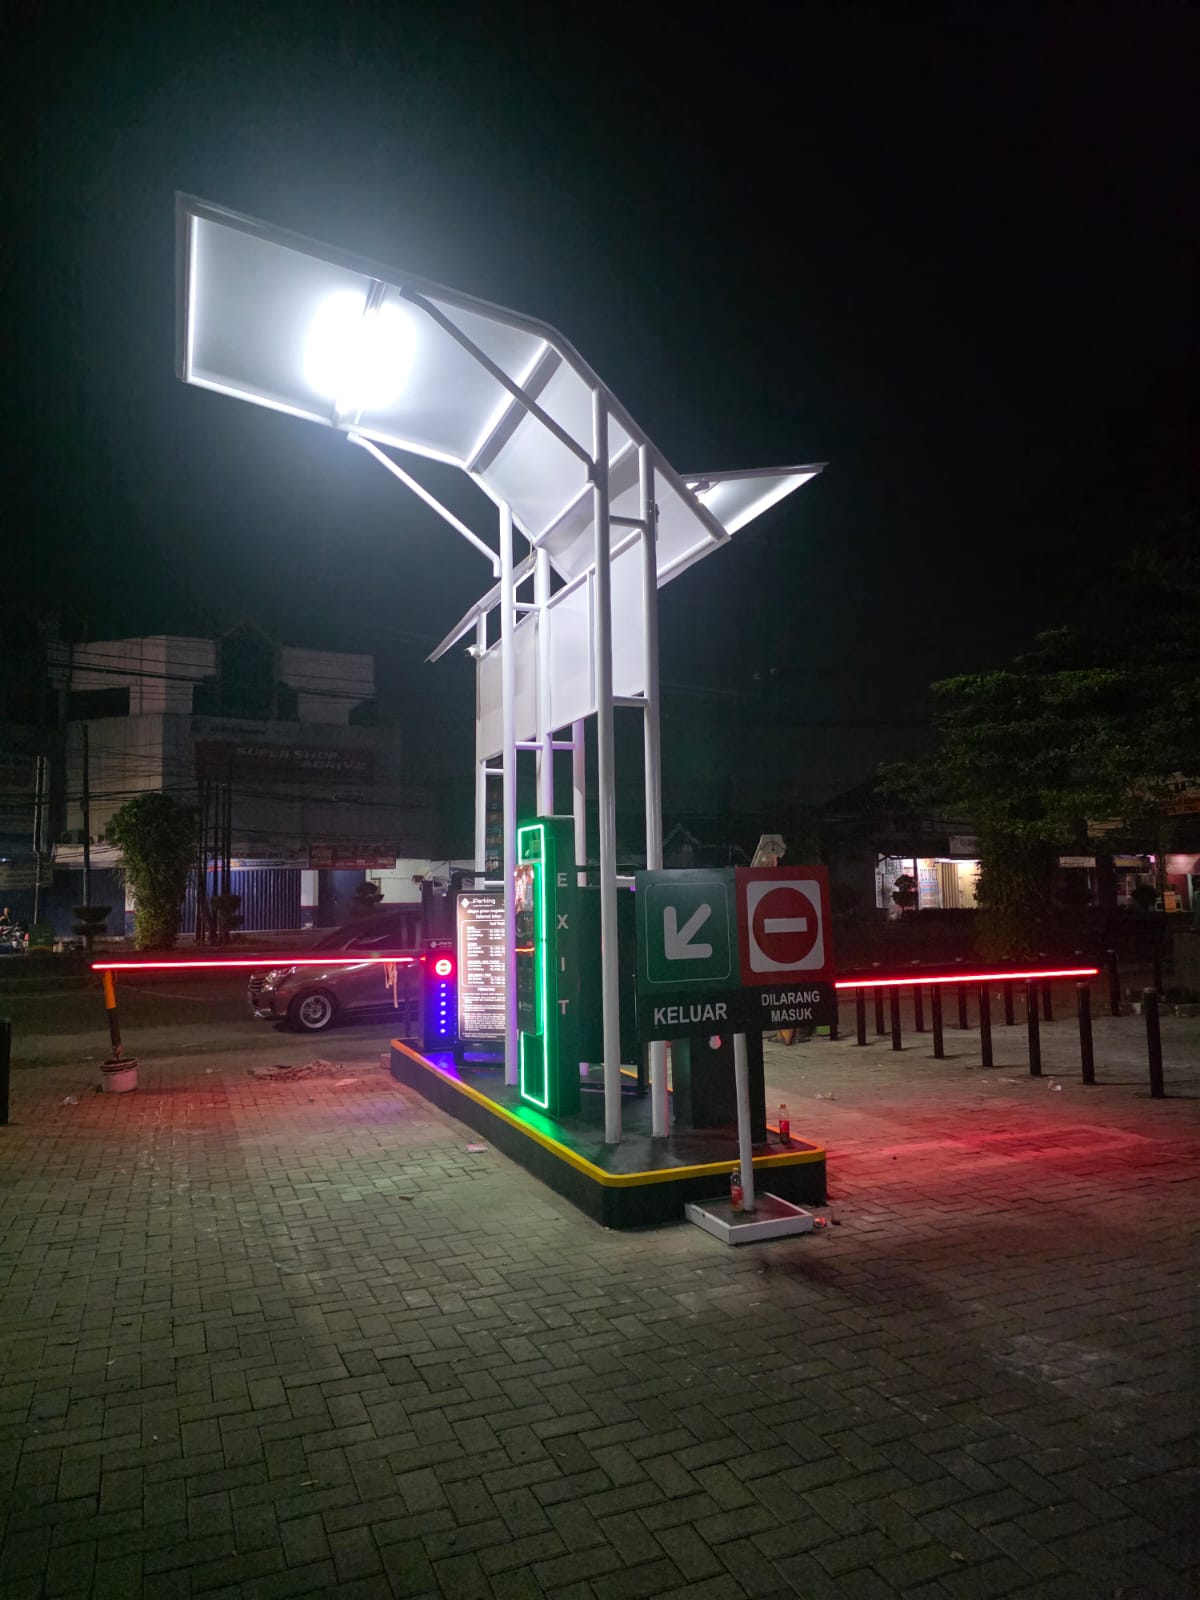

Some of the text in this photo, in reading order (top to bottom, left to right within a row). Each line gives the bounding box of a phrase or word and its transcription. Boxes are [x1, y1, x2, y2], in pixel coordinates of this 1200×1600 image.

[557, 872, 569, 1015] EXIT
[761, 990, 820, 1007] DILARANG
[653, 1002, 728, 1025] KELUAR
[771, 1007, 813, 1022] MASUK
